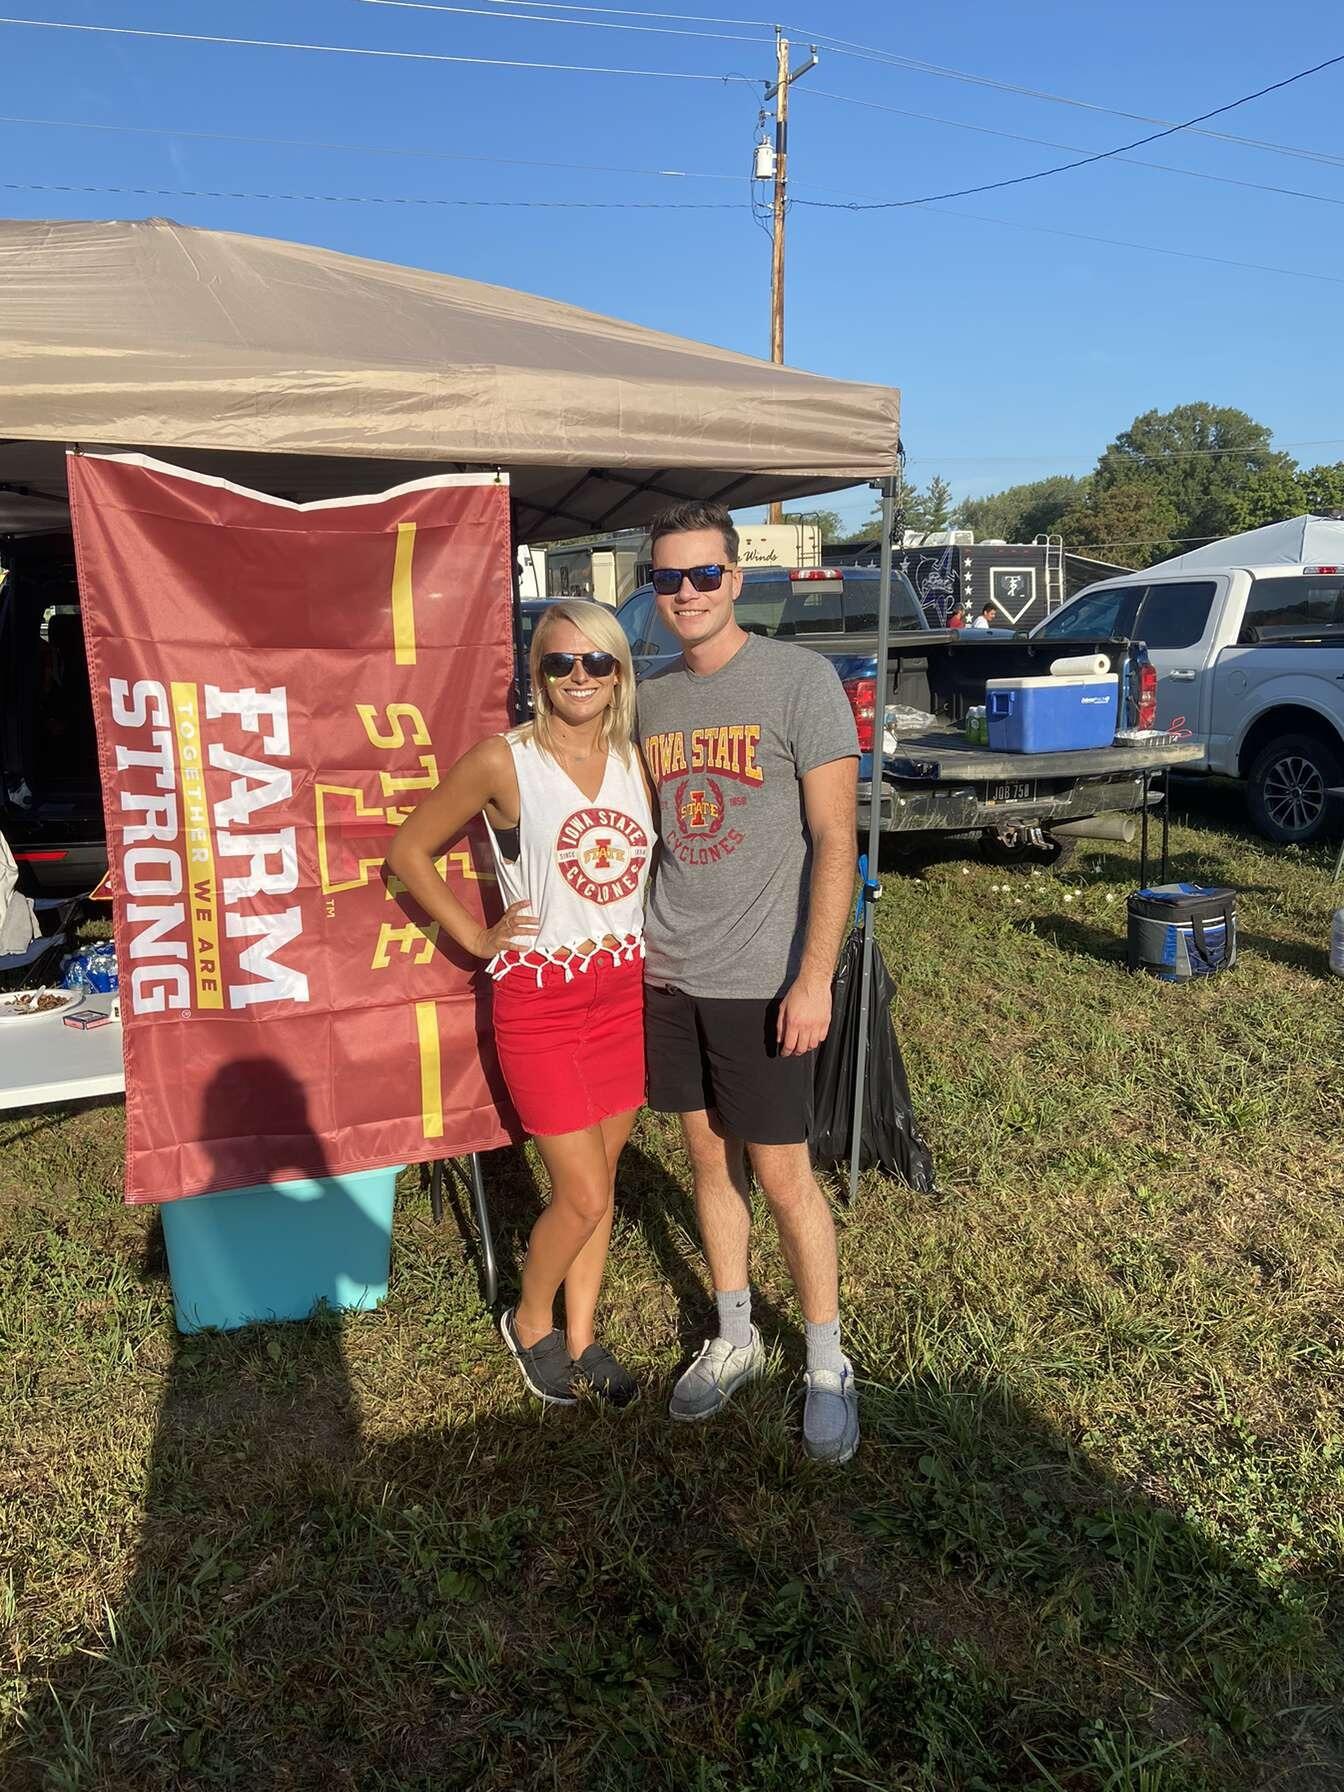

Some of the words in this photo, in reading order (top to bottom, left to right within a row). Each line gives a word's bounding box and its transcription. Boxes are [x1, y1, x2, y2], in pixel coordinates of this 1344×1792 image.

[743, 549, 777, 561] Winds
[176, 702, 210, 864] TOGETHER
[691, 724, 764, 788] STATE
[355, 703, 448, 969] STE
[561, 813, 594, 845] IOWA
[598, 810, 643, 843] STATE
[681, 803, 719, 818] STATE
[109, 677, 191, 1016] STRONG
[204, 684, 310, 1010] FARM
[666, 828, 746, 865] CYCLONES
[193, 879, 213, 922] WE
[198, 937, 218, 992] ARE
